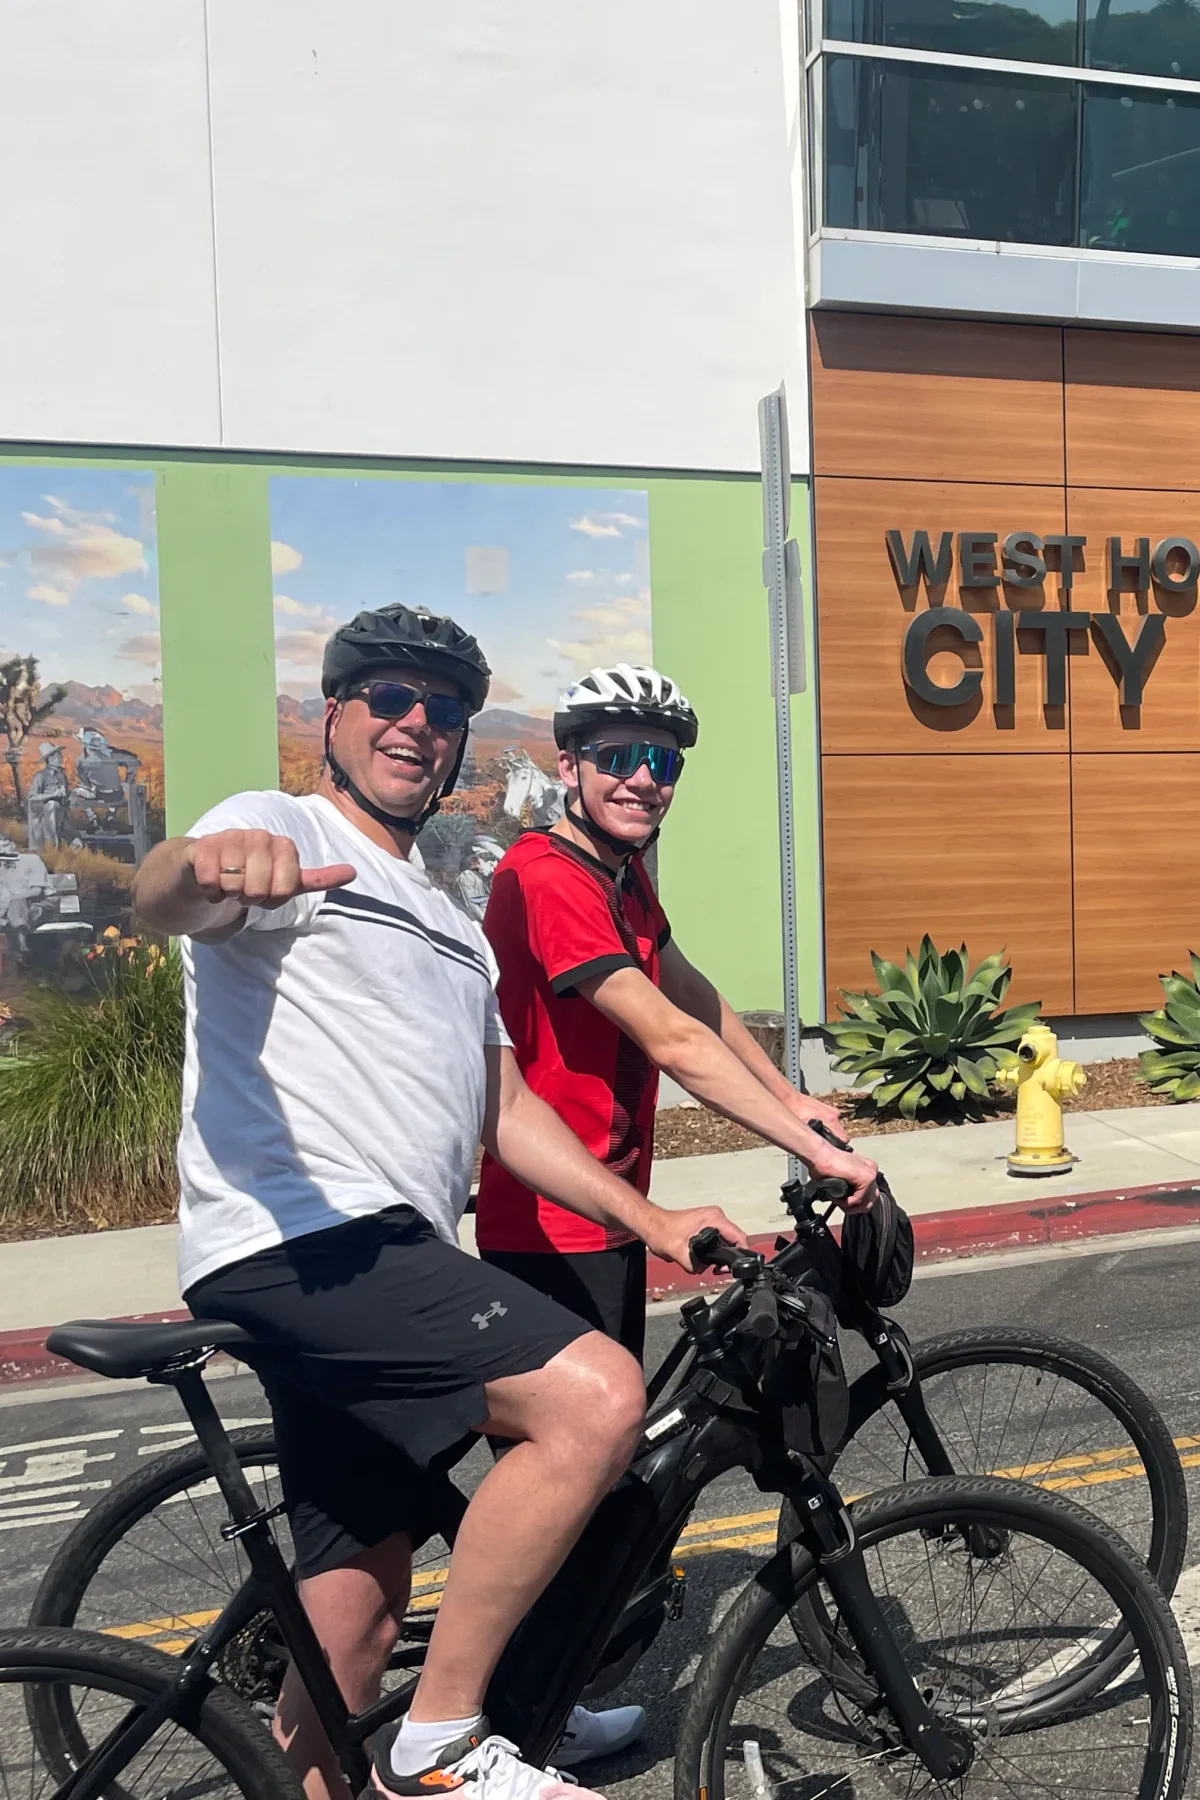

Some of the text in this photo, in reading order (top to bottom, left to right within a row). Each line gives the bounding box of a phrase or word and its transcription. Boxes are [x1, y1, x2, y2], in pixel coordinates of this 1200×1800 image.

[885, 529, 1087, 589] WEST
[903, 606, 1168, 707] CITY
[1168, 1666, 1178, 1695] GIANT
[1162, 1716, 1178, 1799] CROSSCUT
